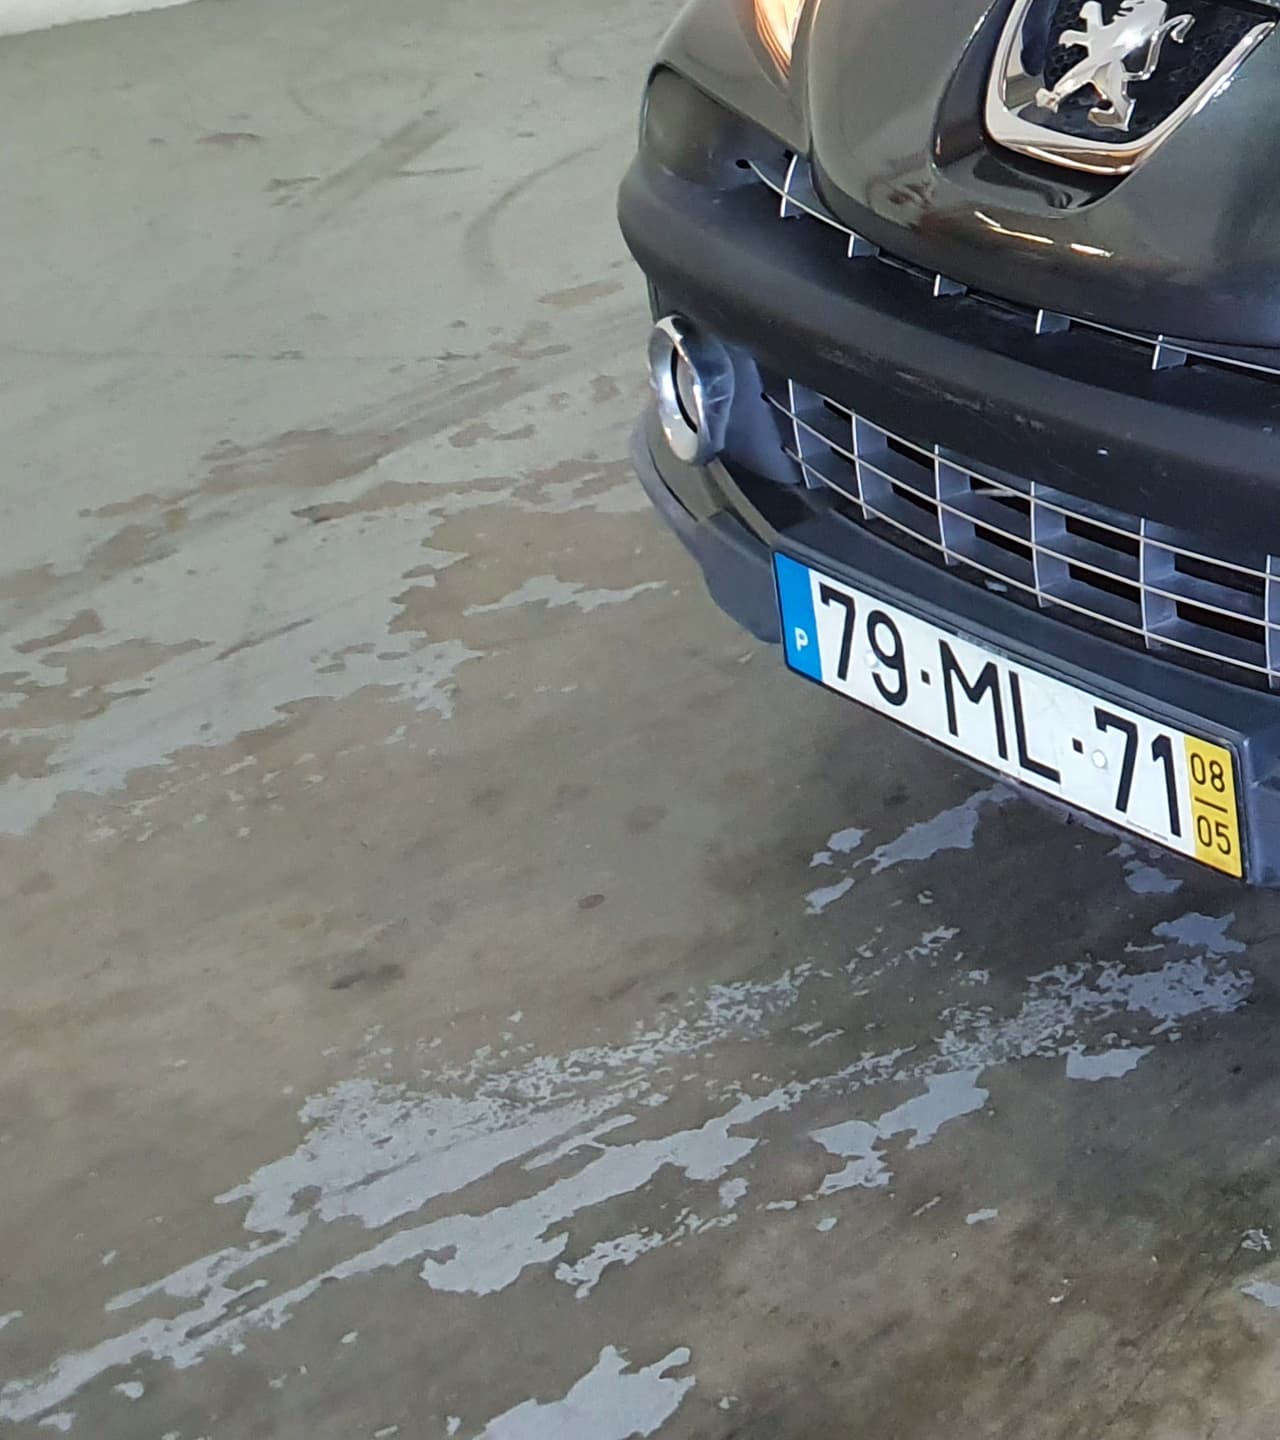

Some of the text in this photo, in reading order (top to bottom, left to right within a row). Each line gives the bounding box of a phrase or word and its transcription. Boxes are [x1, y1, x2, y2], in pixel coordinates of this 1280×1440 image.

[794, 626, 809, 652] P
[1190, 752, 1226, 793] 08
[1197, 814, 1232, 855] 05
